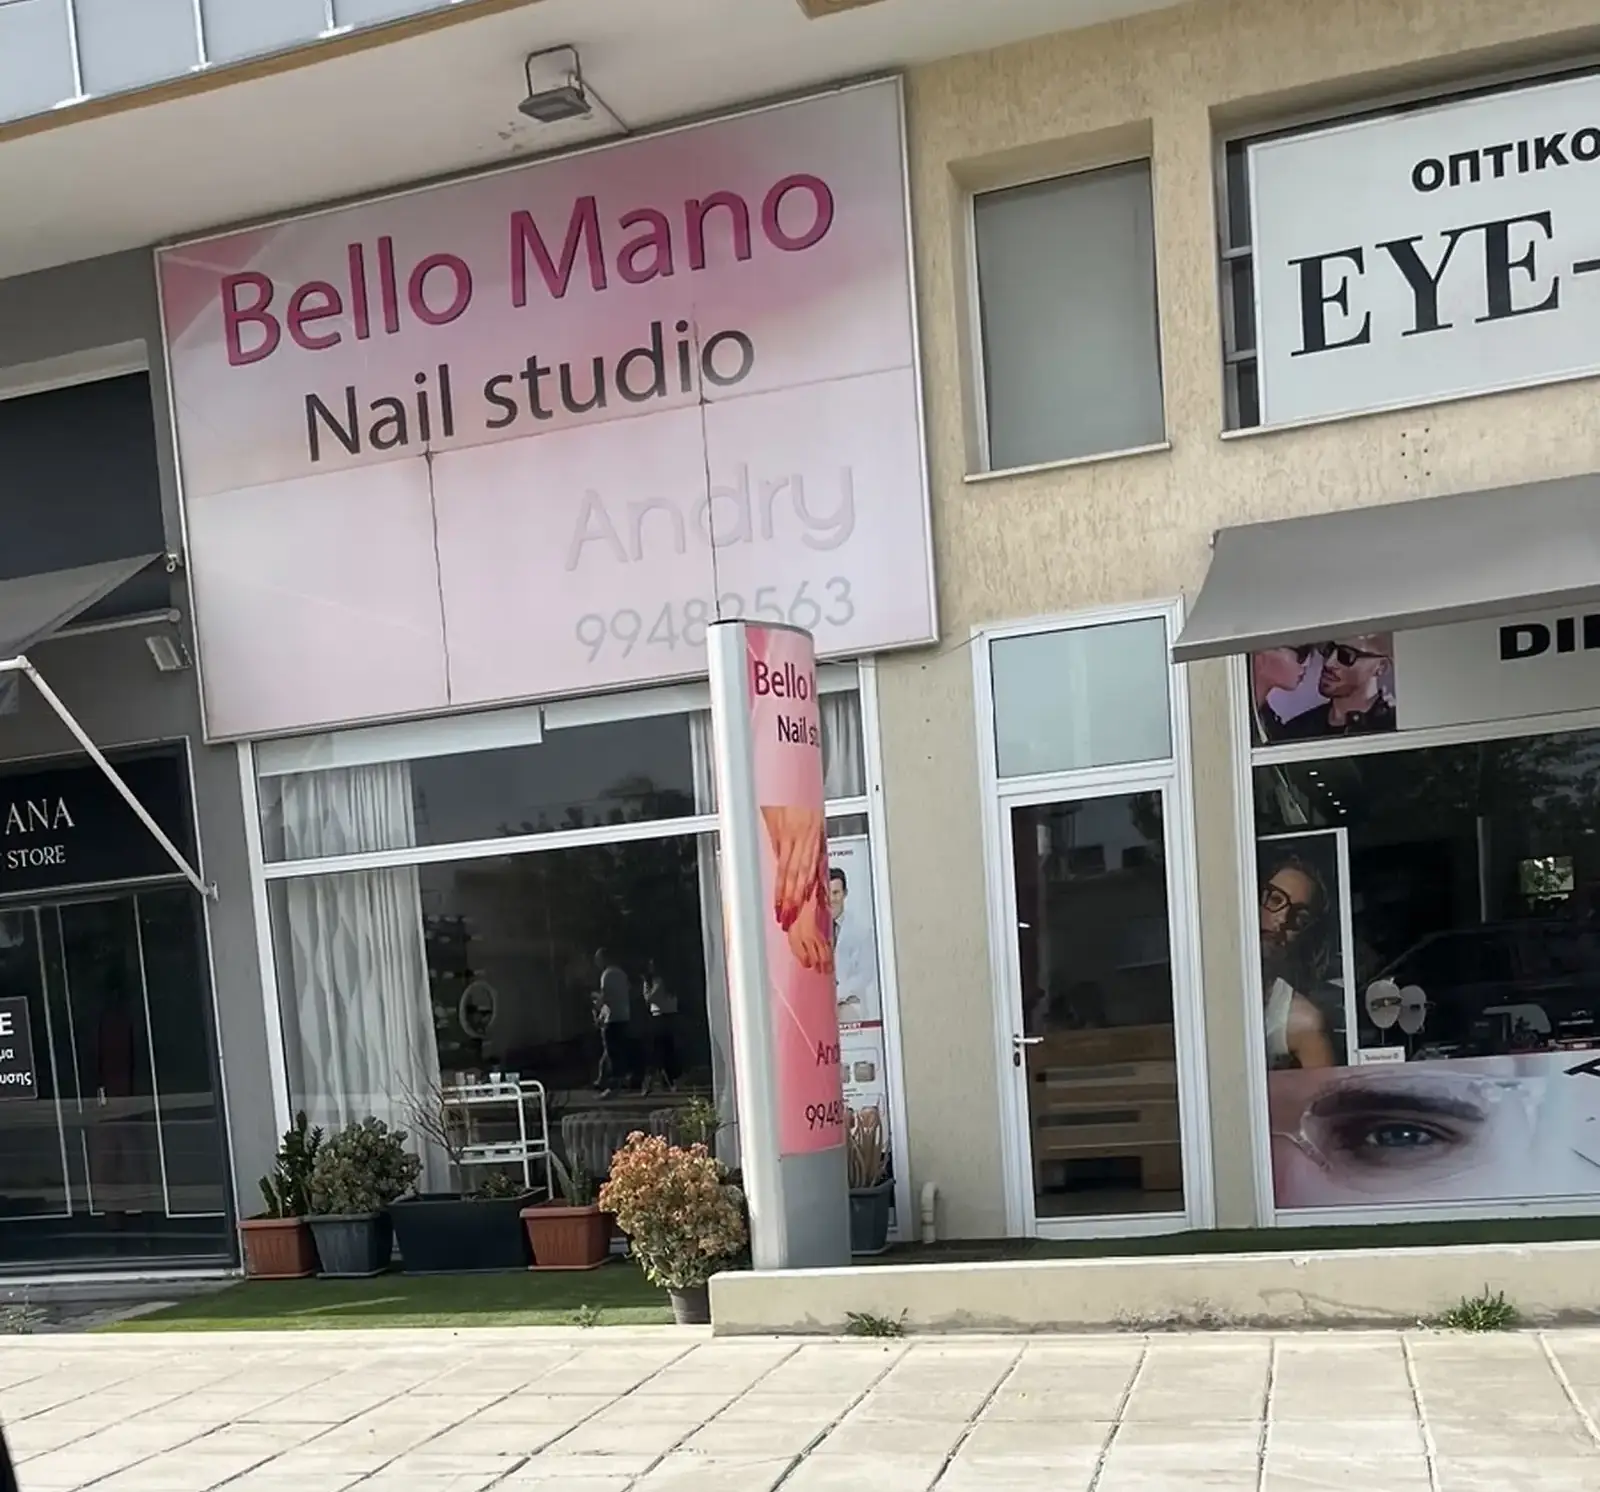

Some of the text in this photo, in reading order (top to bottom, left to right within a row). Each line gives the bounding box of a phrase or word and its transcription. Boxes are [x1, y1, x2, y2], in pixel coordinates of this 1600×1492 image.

[219, 172, 835, 366] Bello Mano
[304, 320, 755, 462] Nail studio
[564, 462, 856, 572] Andry
[753, 661, 808, 701] Bello
[777, 714, 808, 744] Nail
[5, 796, 75, 835] ANA
[7, 844, 66, 869] STORE
